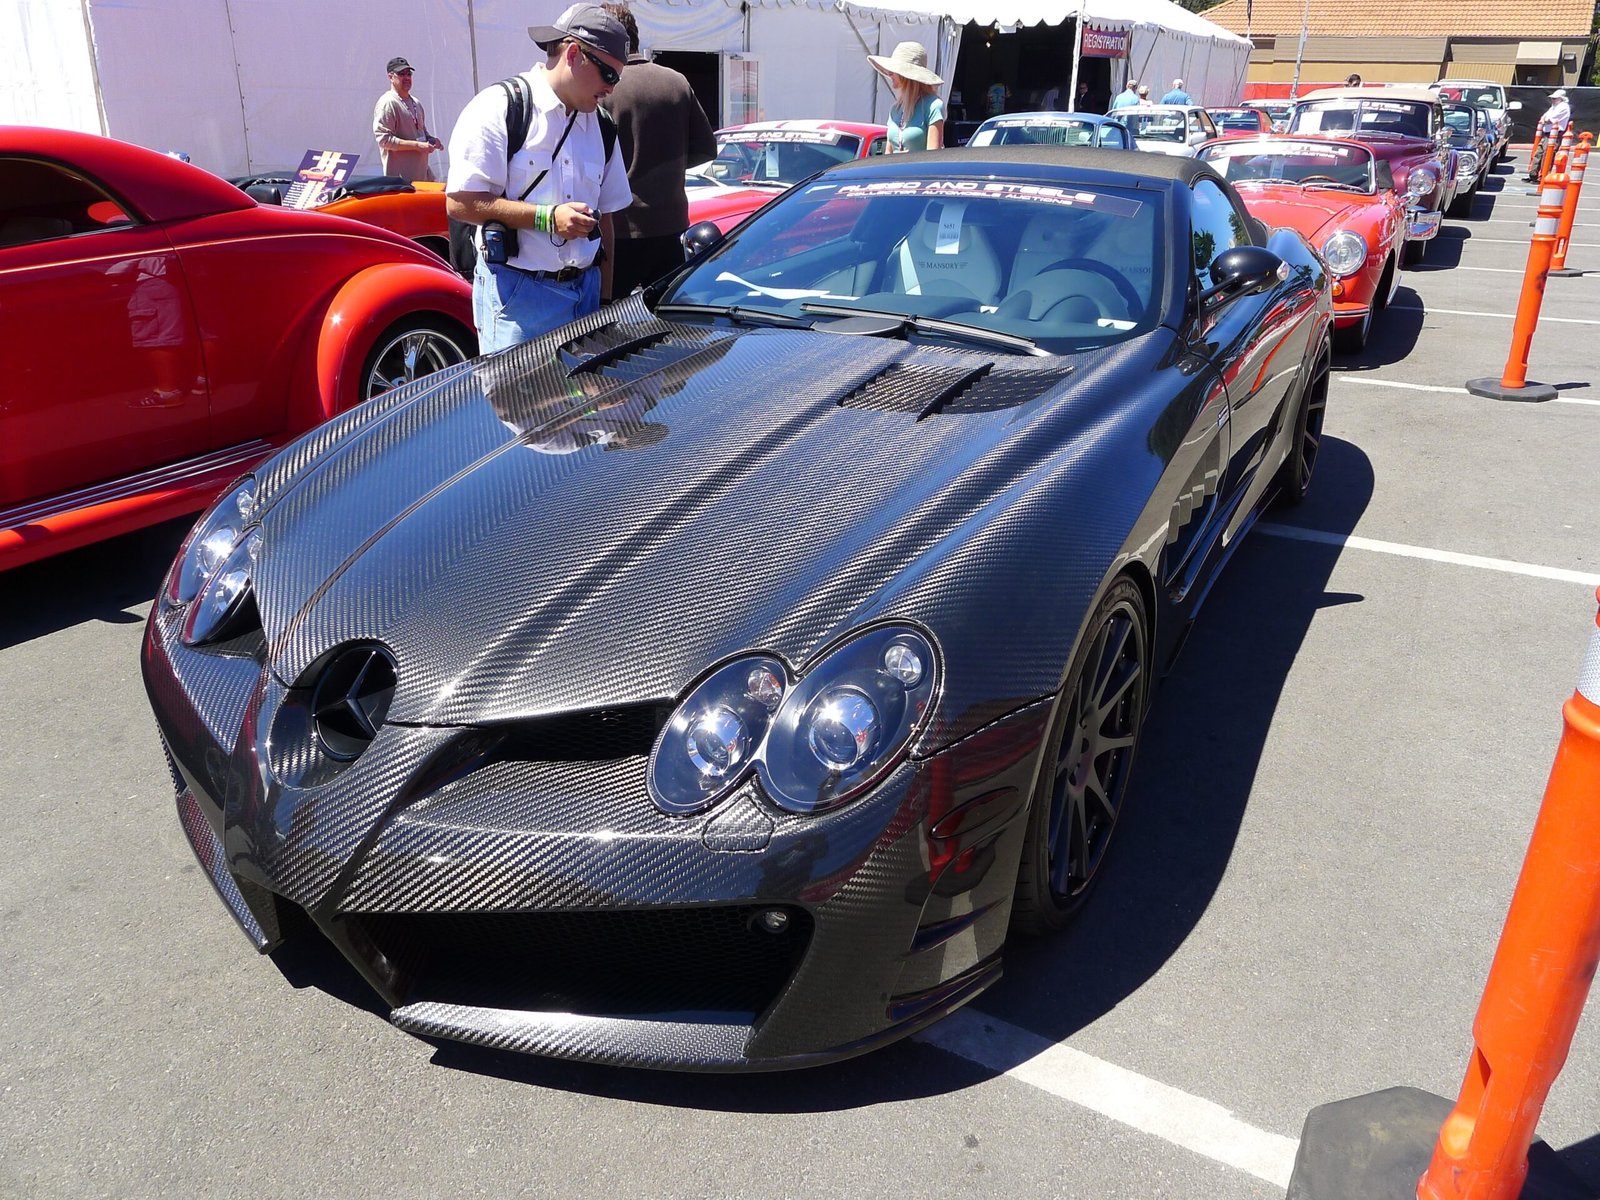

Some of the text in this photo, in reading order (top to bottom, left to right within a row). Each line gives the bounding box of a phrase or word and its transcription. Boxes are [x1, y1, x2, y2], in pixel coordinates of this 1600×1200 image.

[1083, 33, 1125, 51] REGISTRATIO
[838, 181, 1097, 202] RUSSO AND STEELE
[922, 190, 1001, 198] AUTOMOBILE
[1005, 193, 1073, 205] AUCTIONS
[926, 262, 959, 270] MANSORY
